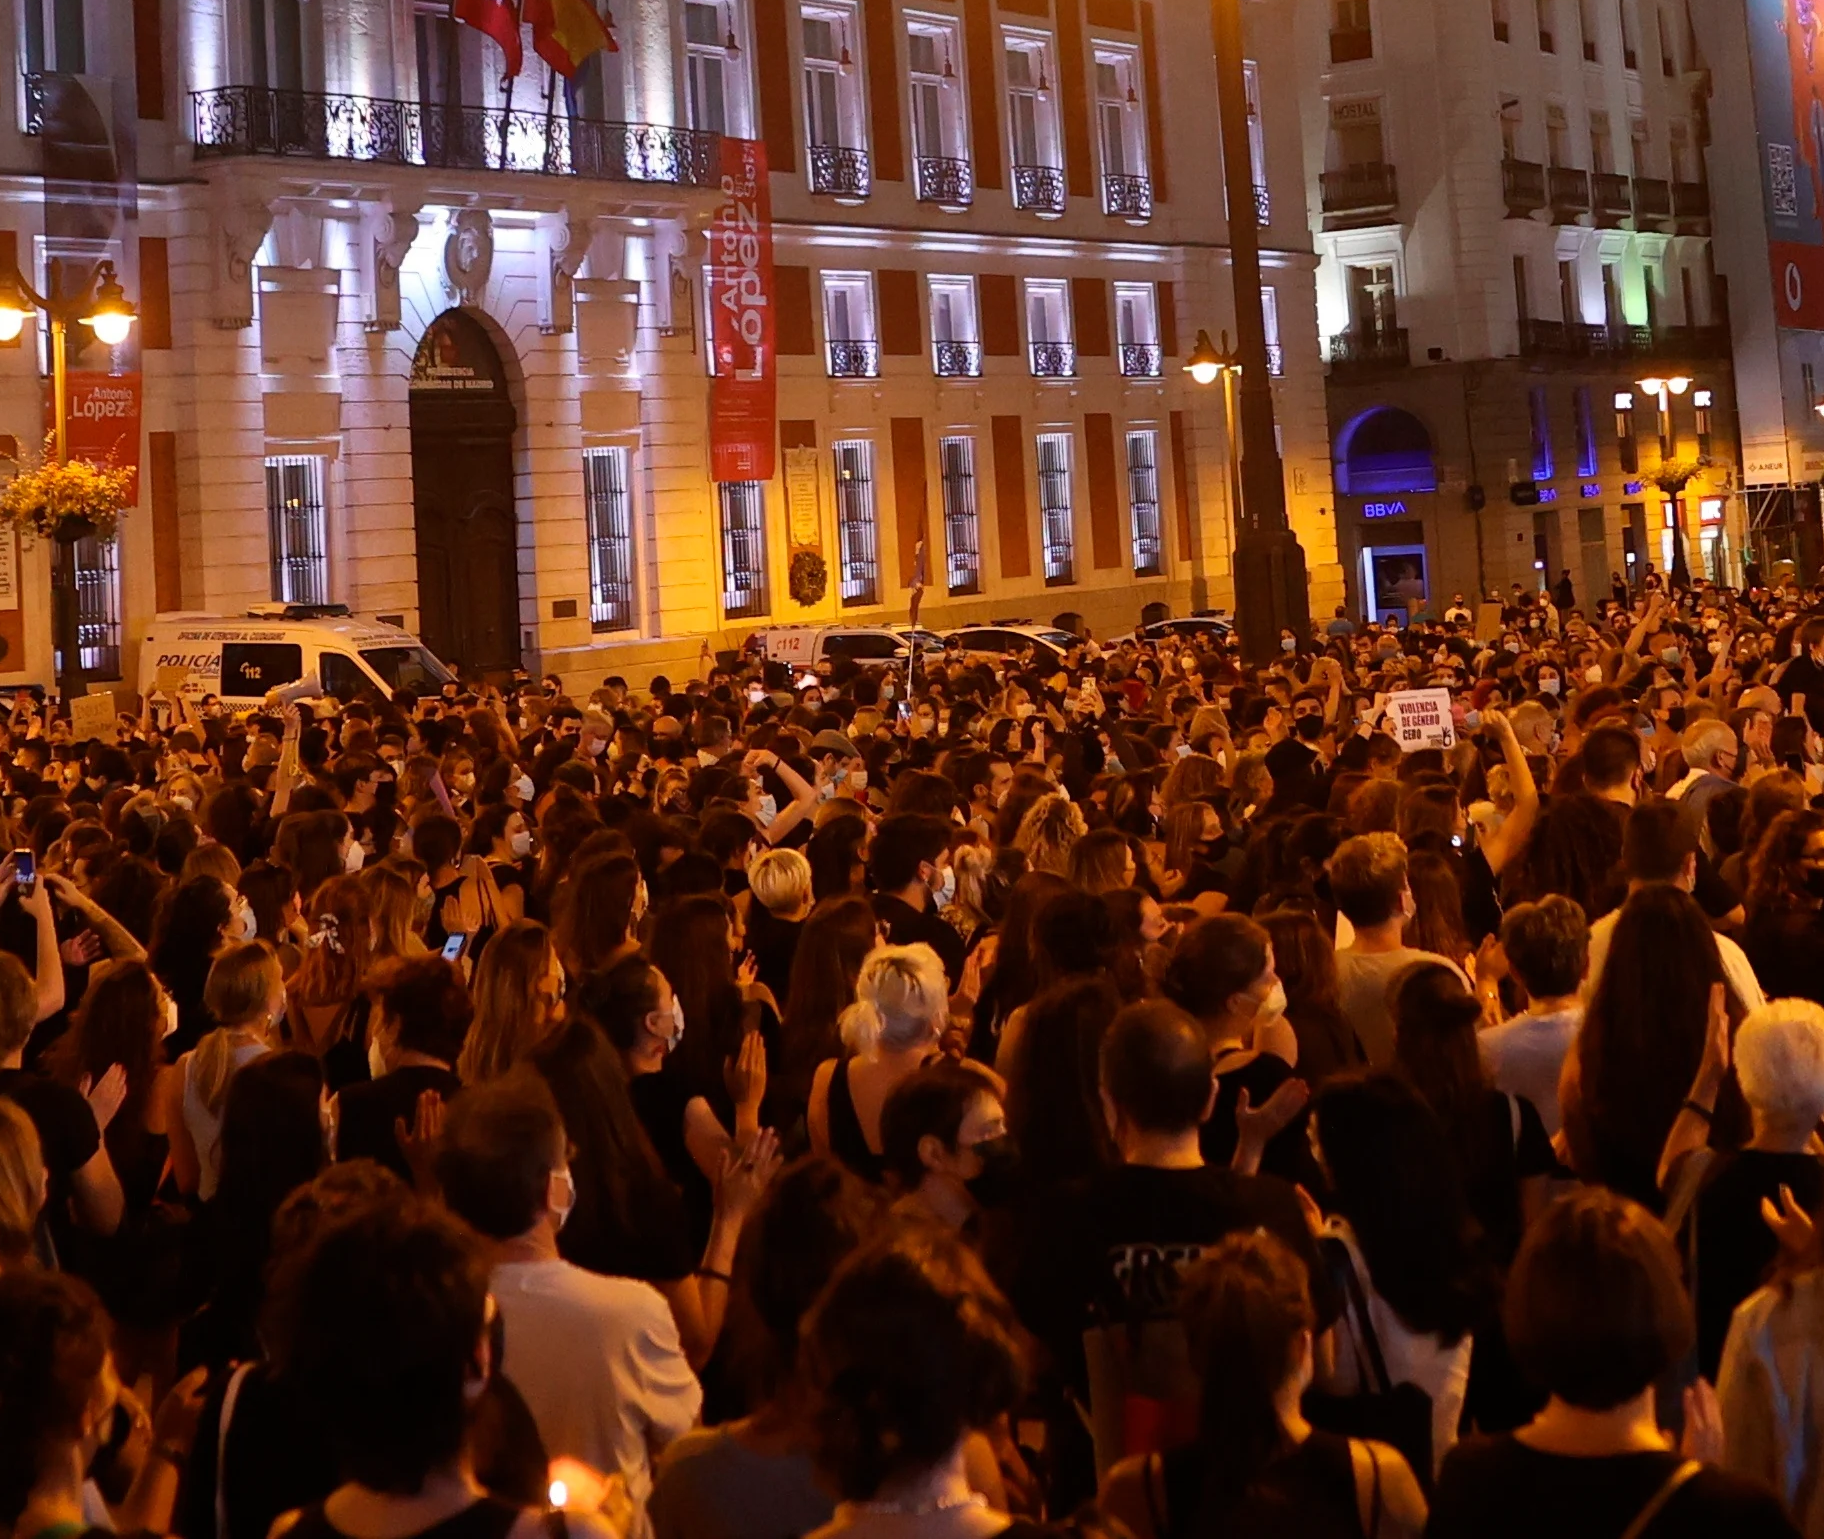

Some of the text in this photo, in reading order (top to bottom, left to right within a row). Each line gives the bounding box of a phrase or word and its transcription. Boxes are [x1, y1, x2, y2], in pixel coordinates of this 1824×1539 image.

[720, 174, 739, 311] Antonio
[731, 202, 768, 382] López
[93, 387, 133, 400] Antonio
[73, 393, 125, 422] López
[1364, 501, 1406, 518] BBVA
[782, 637, 800, 650] 112
[156, 651, 221, 668] POLICÍA
[245, 666, 262, 679] 112
[1398, 701, 1438, 714] VIOLENCIA
[1401, 715, 1411, 728] DE
[1402, 728, 1422, 741] CERO
